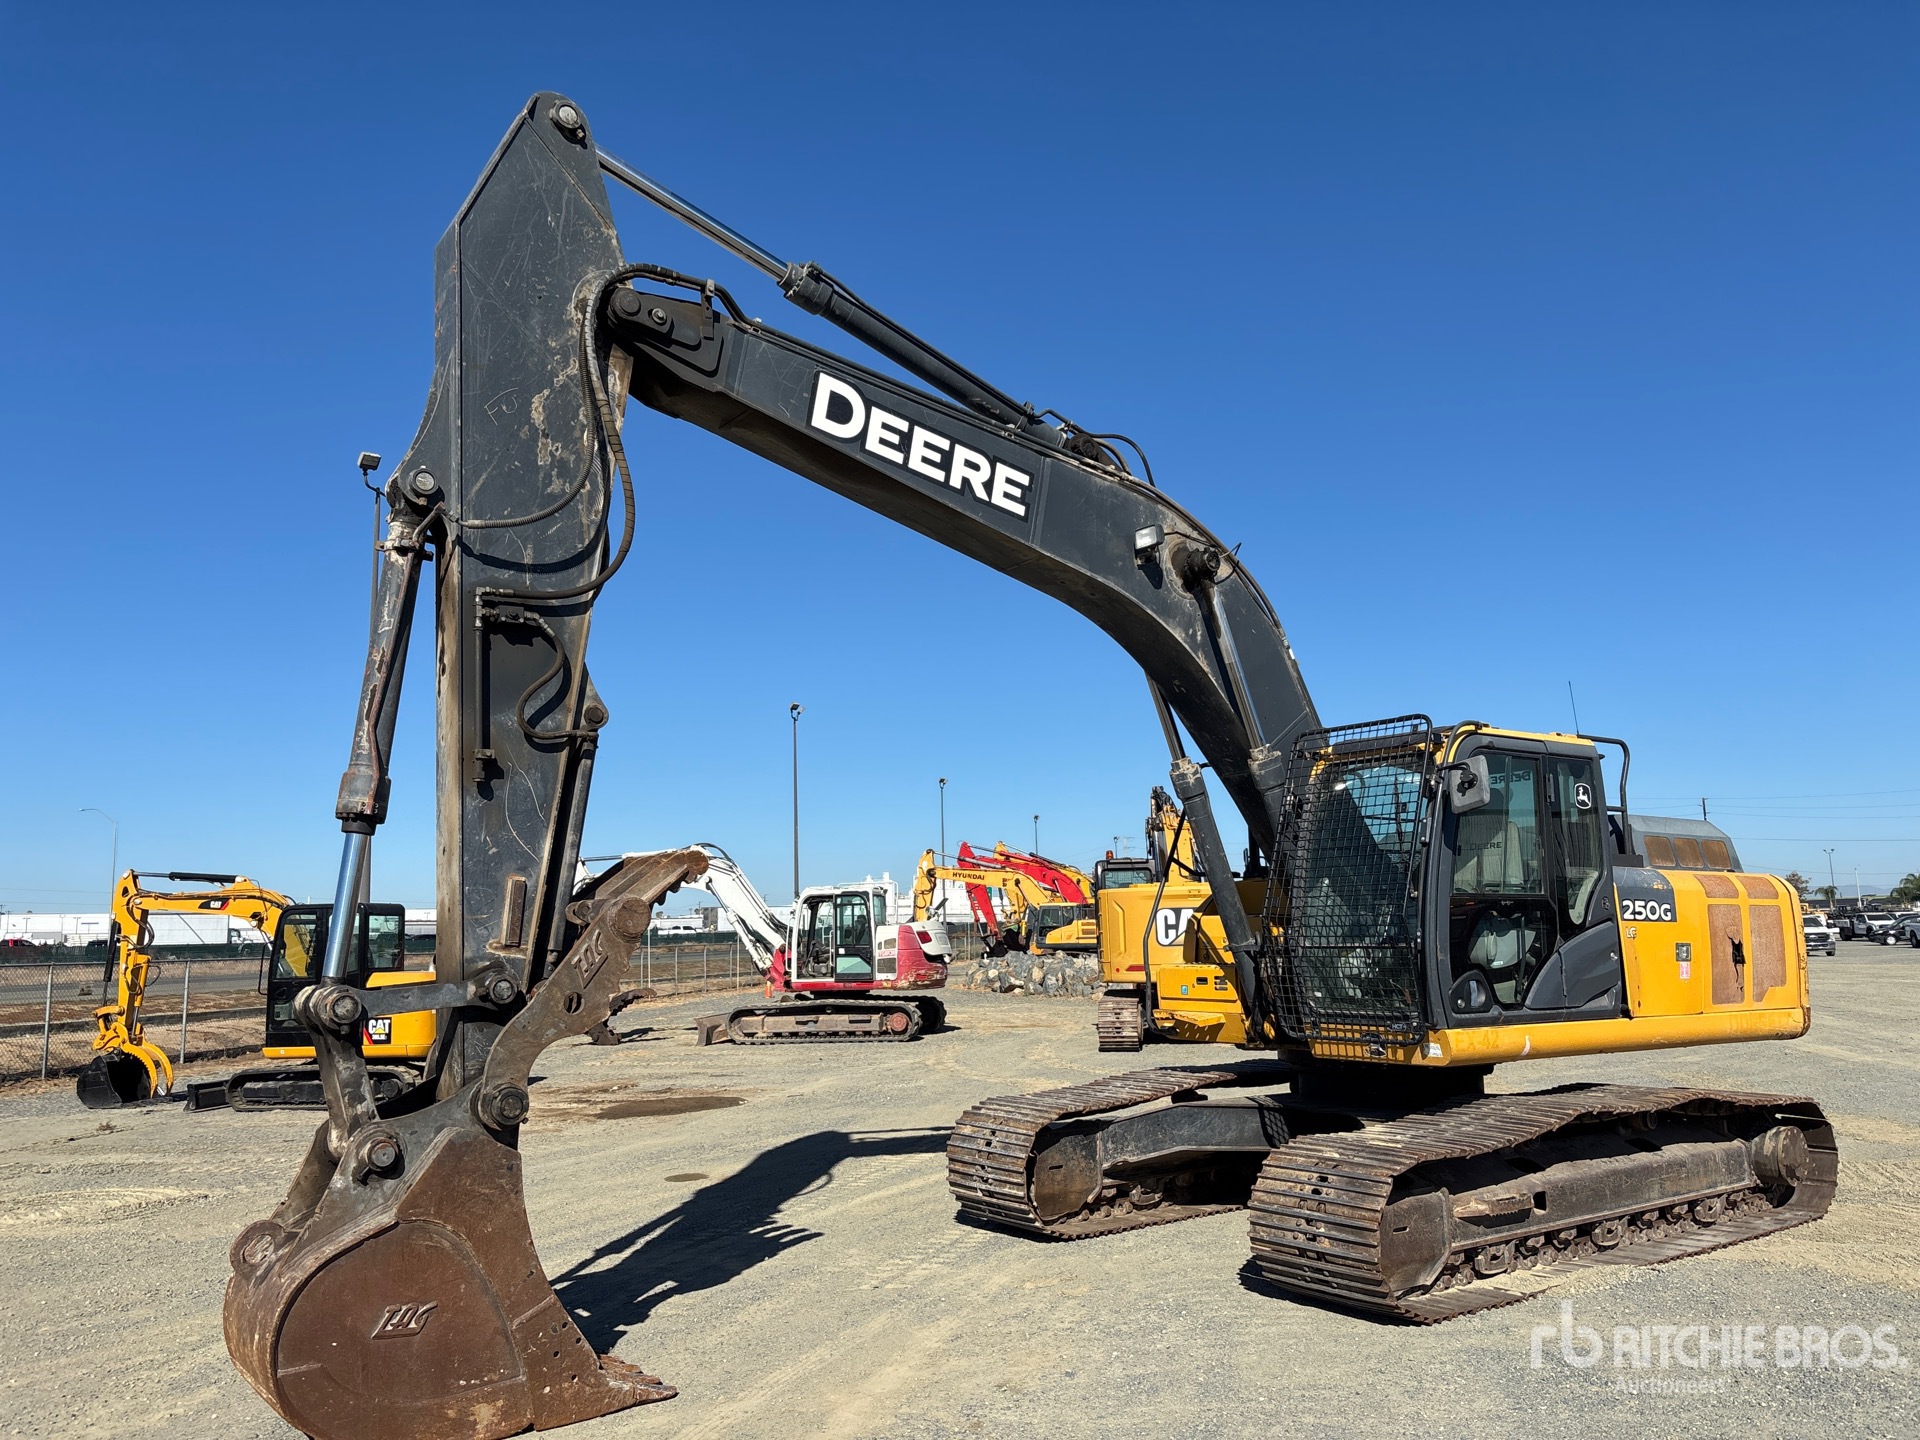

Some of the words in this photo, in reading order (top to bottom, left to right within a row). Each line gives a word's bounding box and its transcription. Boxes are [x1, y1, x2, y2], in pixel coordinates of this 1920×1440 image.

[811, 372, 1030, 516] DEERE
[952, 872, 985, 880] HYUNDAI
[210, 901, 222, 909] CAT
[1622, 899, 1672, 921] 250G
[1156, 908, 1194, 946] CA
[368, 1019, 391, 1034] CAT
